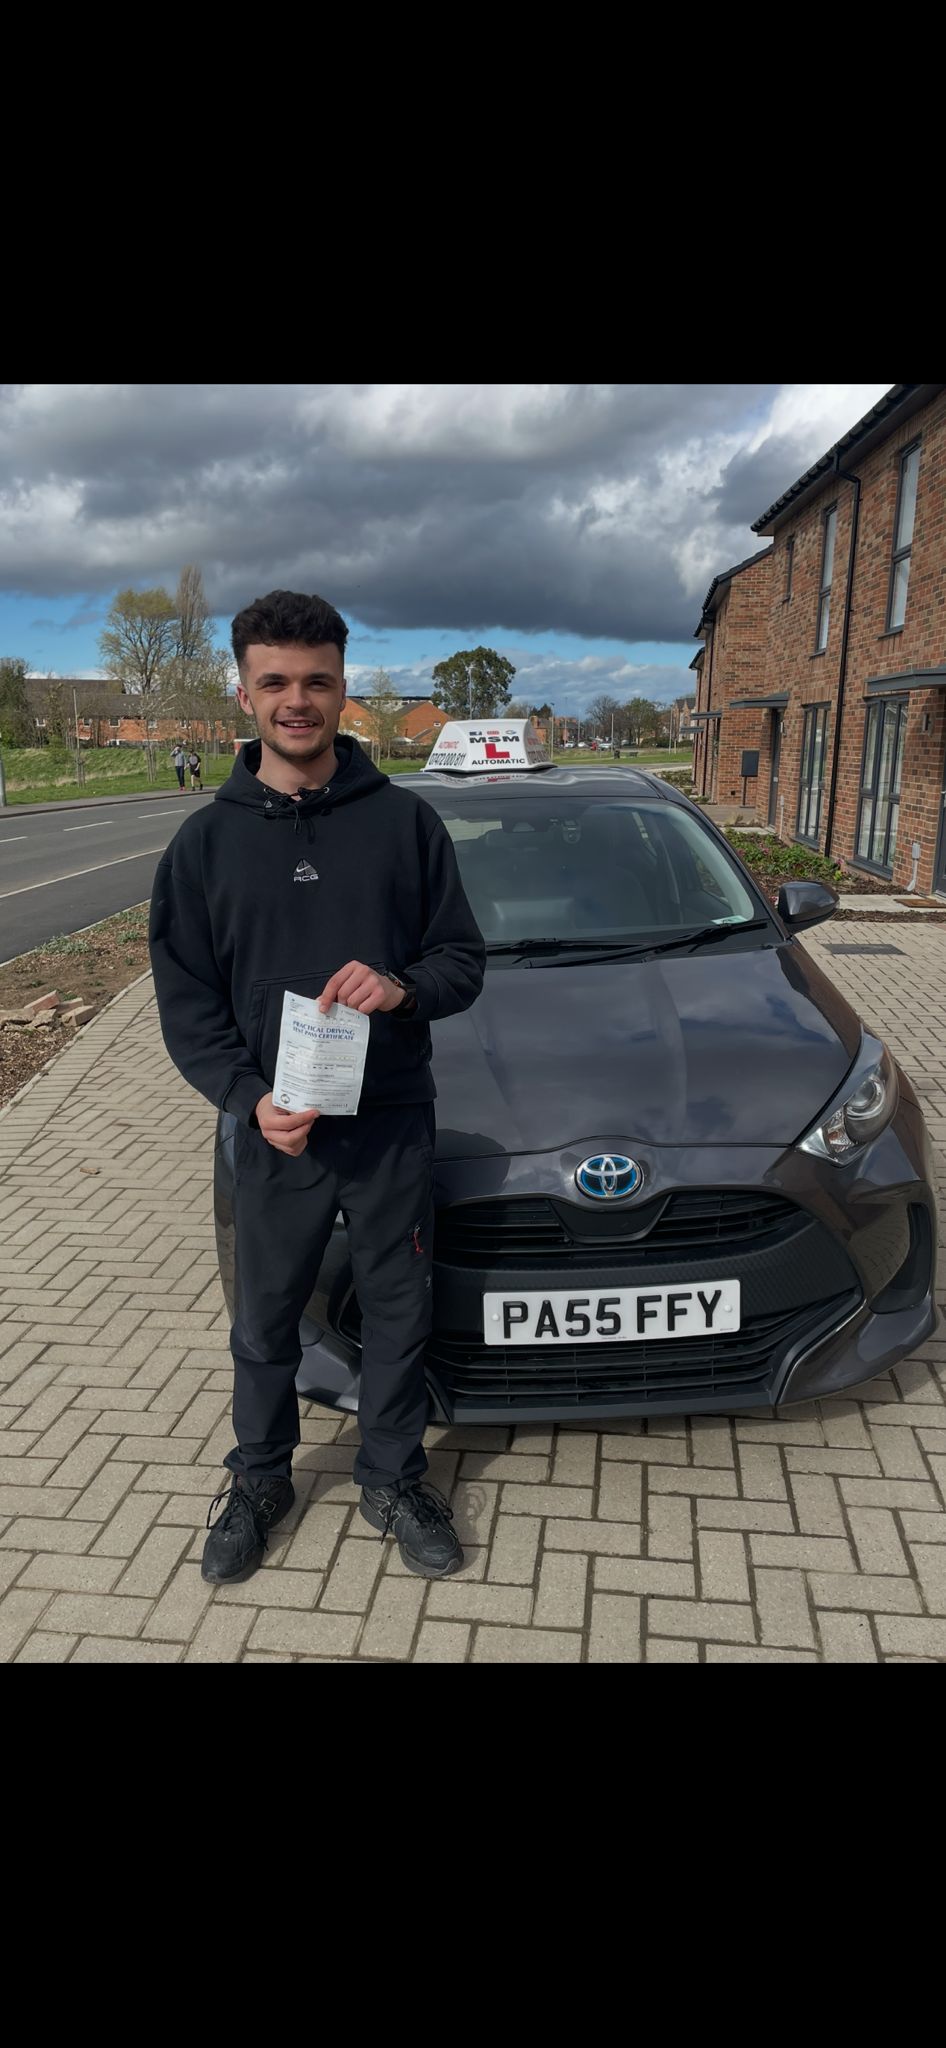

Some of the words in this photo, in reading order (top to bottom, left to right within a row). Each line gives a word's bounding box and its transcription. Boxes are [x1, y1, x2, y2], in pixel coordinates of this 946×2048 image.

[485, 743, 510, 759] L
[293, 1020, 324, 1033] PRACTICAL
[326, 1027, 355, 1036] DRIVING
[318, 1033, 354, 1041] CERTIFICATE
[503, 1298, 622, 1339] PA55
[637, 1290, 722, 1333] FFY
